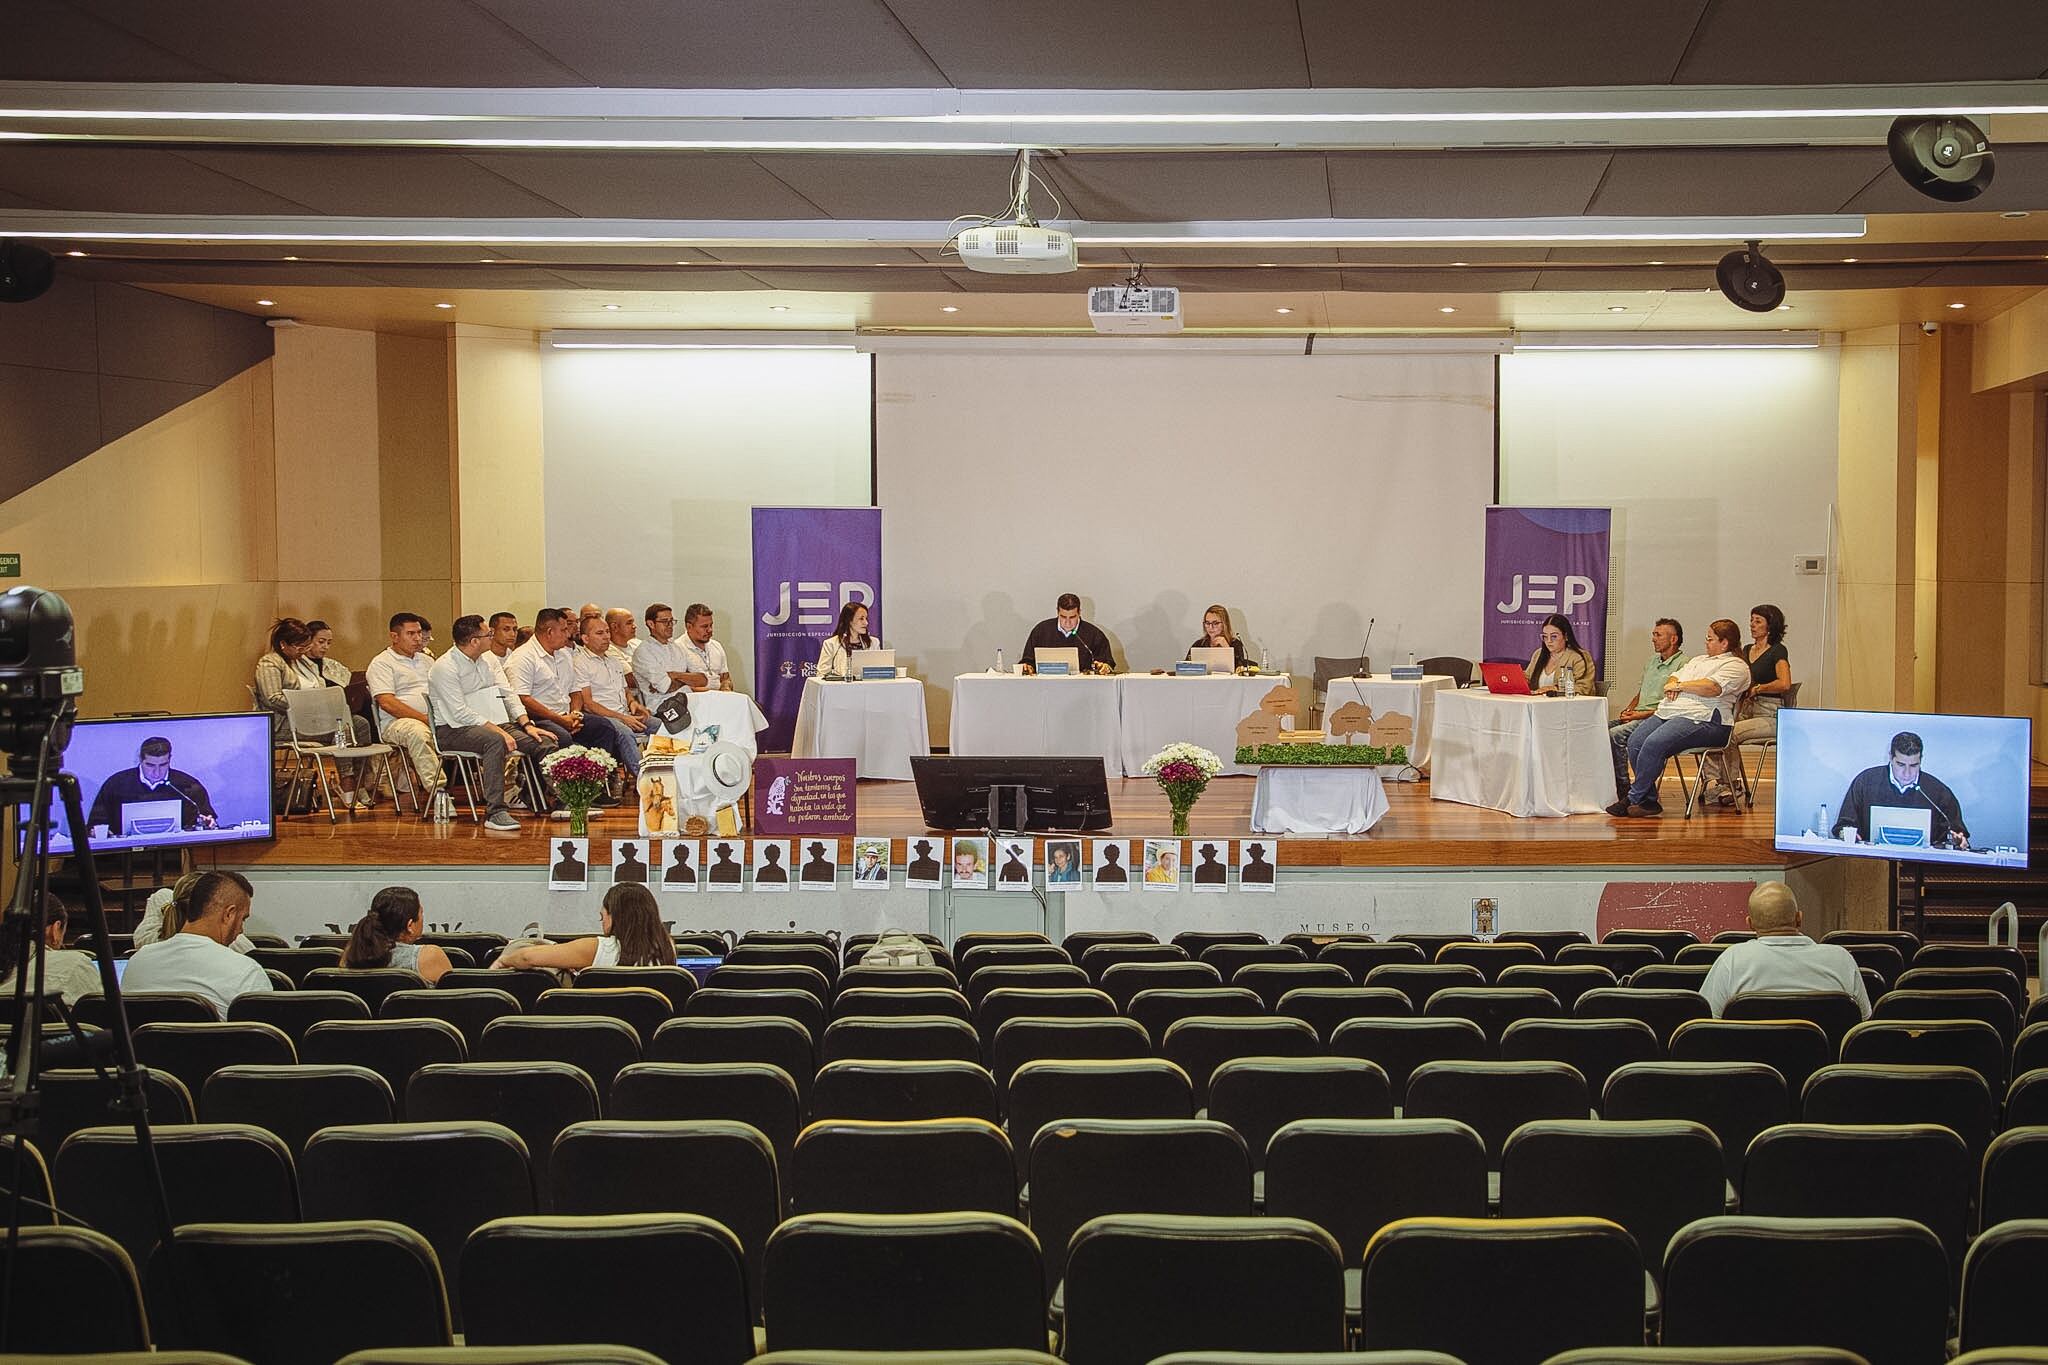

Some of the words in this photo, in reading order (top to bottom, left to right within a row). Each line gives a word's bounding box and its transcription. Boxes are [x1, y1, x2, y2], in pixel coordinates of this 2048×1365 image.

[1496, 574, 1596, 615] JEP
[761, 581, 875, 626] JEP
[823, 774, 846, 785] cuerpos
[832, 782, 842, 791] de
[827, 791, 836, 800] los
[836, 792, 846, 804] que
[821, 802, 835, 810] vida
[835, 803, 846, 813] que
[788, 815, 796, 823] no
[1300, 922, 1370, 933] MUSEO
